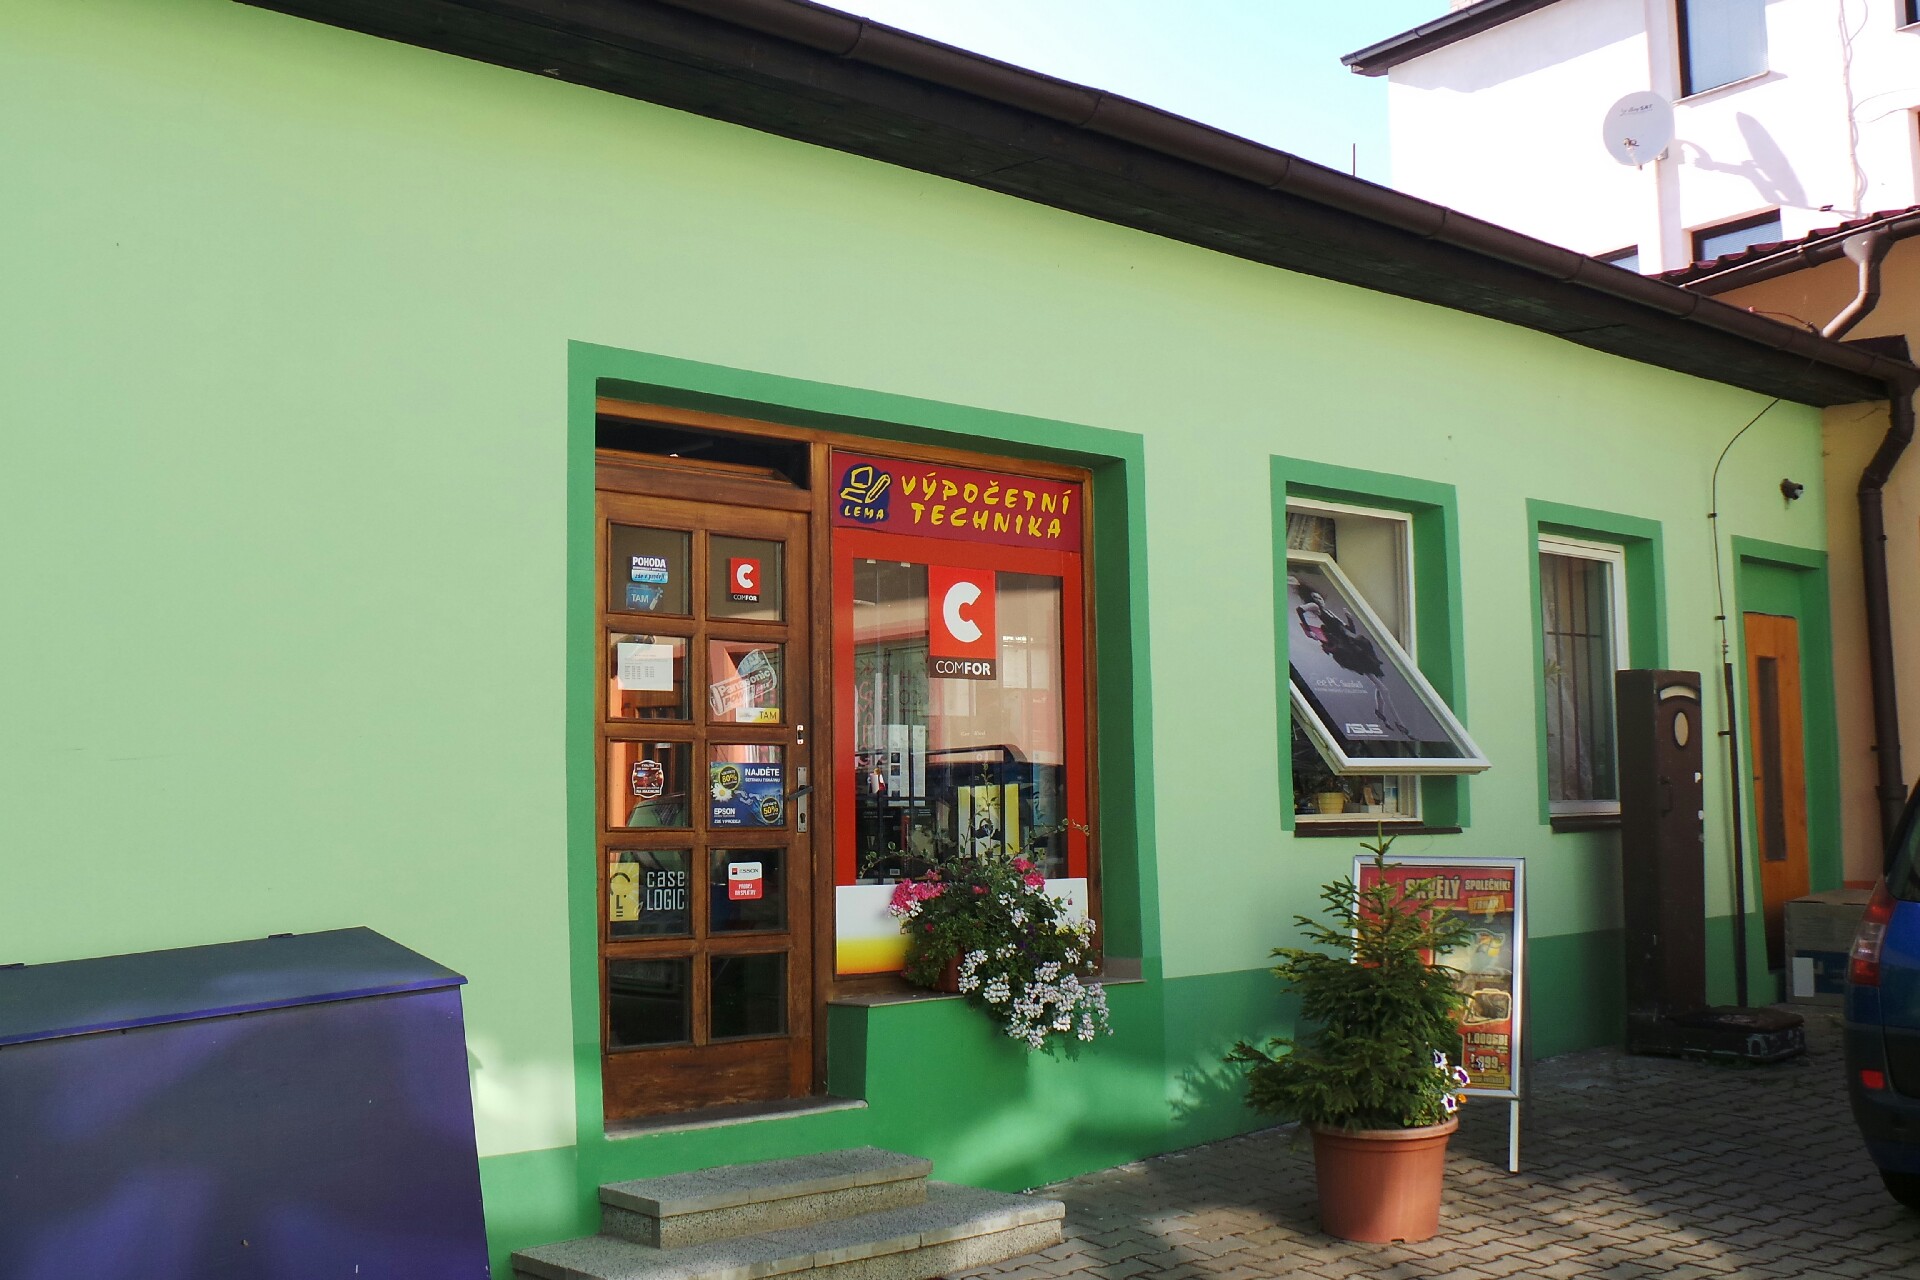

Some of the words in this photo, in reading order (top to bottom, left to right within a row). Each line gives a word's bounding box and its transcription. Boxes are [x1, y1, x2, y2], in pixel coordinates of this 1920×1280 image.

[901, 471, 1072, 515] VÝPOČETNÍ
[844, 504, 885, 520] LEMA
[911, 502, 1062, 538] TECHNIKA
[632, 556, 667, 568] POHODA
[631, 593, 649, 603] TAM
[733, 594, 758, 602] COMFOR
[942, 581, 983, 643] C
[935, 660, 991, 676] COMFOR
[717, 669, 771, 697] Panasonic
[760, 710, 777, 720] TAM
[1345, 723, 1384, 734] ASUS
[744, 766, 780, 777] NAJDĚTE
[713, 807, 736, 815] EPSON
[763, 804, 779, 815] 50%
[646, 871, 685, 888] case
[1464, 878, 1512, 891] SPOLEČNÍK!
[646, 888, 685, 911] LOGIC
